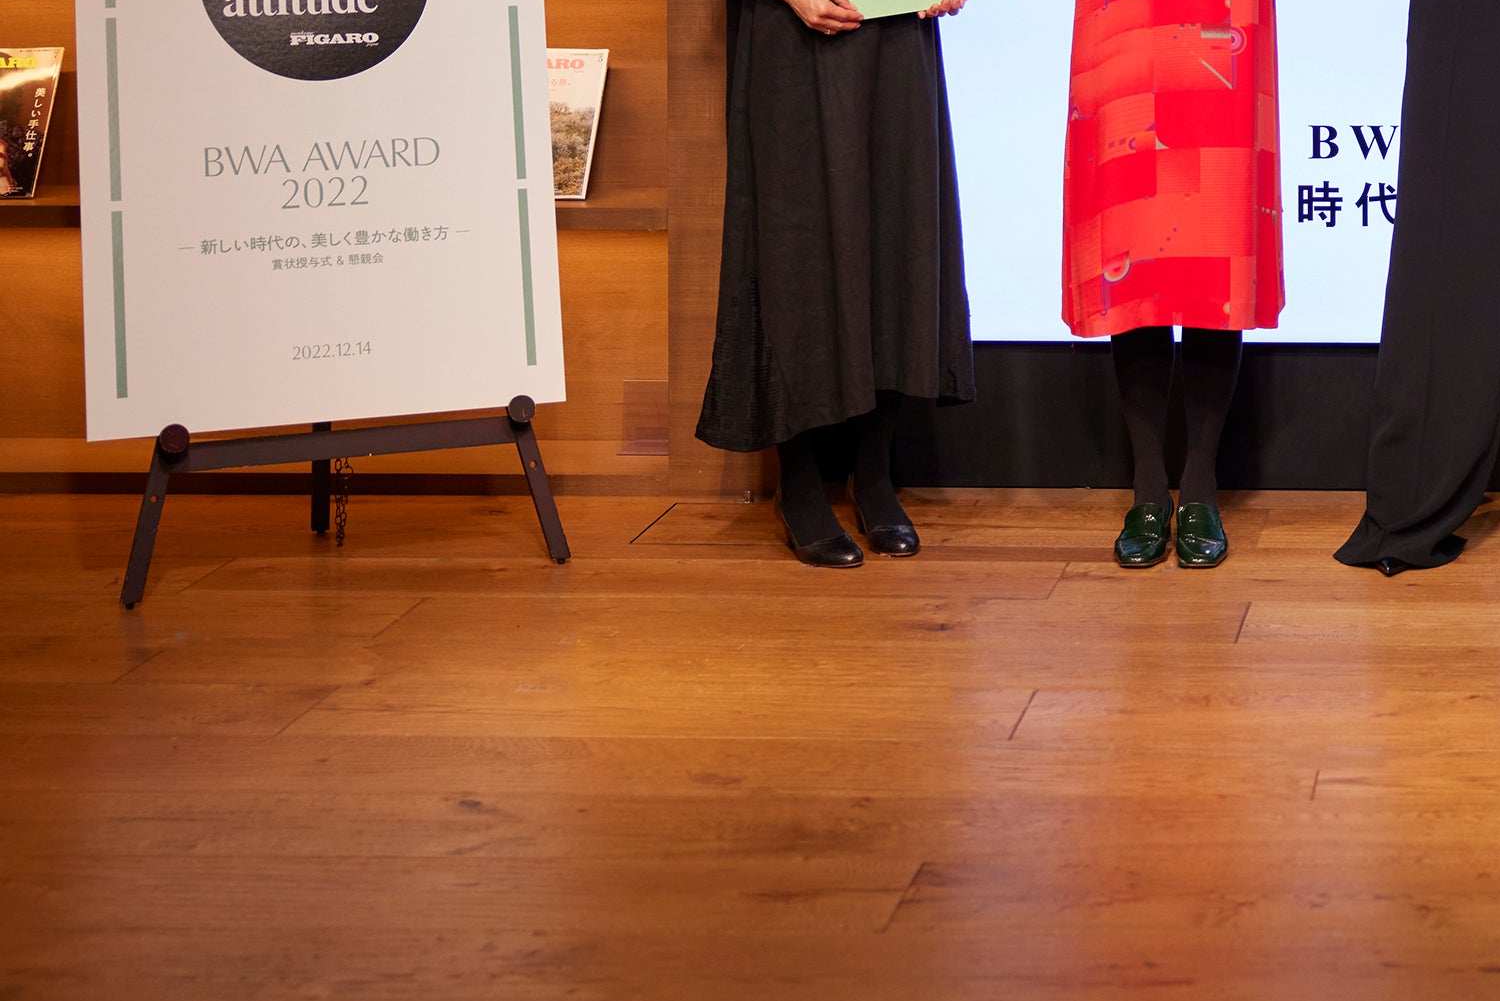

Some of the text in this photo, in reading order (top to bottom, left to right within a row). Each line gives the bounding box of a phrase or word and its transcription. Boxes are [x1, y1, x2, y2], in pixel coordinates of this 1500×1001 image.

[289, 32, 380, 46] FIGARO
[23, 87, 46, 158] 美しい手仕事。
[204, 136, 441, 178] BWA AWARD
[281, 175, 370, 210] 2022
[200, 225, 449, 255] 新しい時代の、美しく豊かな働き方
[271, 252, 384, 270] 賞状授与式 & 懇親会
[292, 341, 372, 361] 2022.12.14
